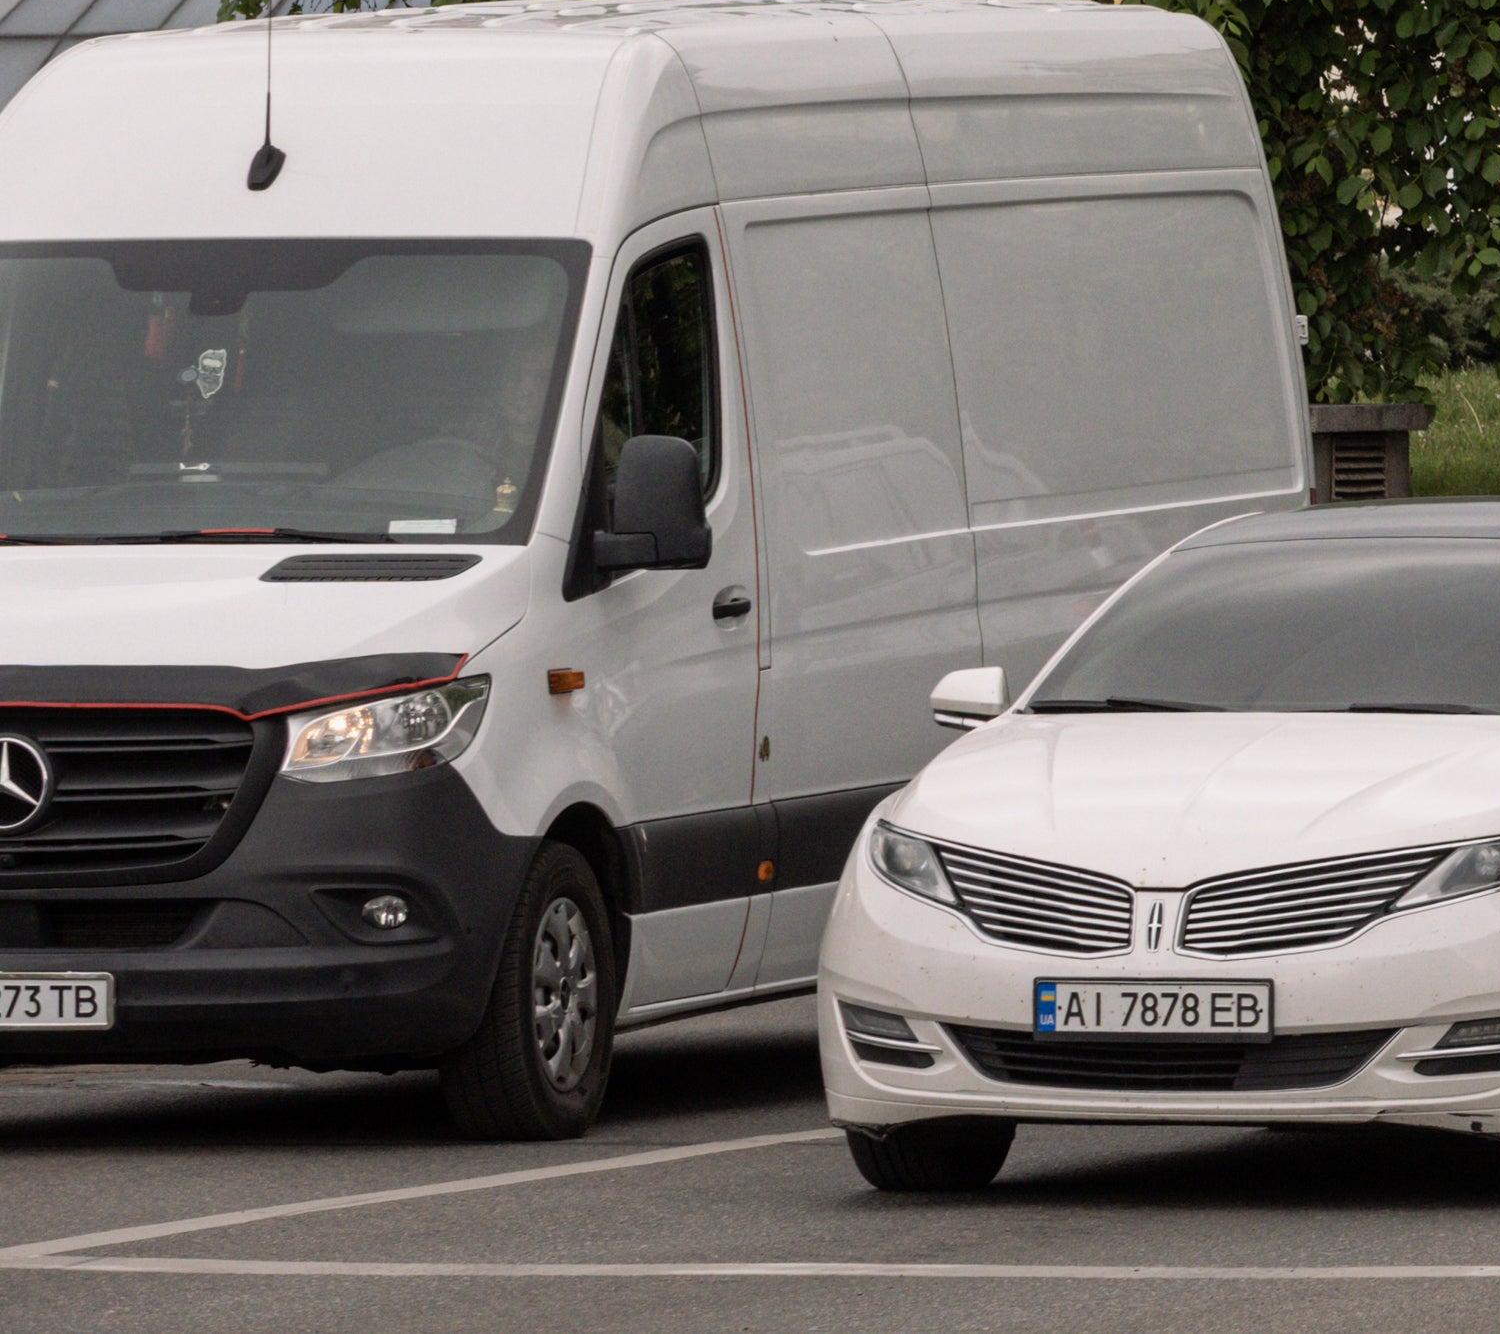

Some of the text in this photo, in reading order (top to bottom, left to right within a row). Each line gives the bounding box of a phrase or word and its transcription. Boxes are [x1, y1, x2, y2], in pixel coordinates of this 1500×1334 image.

[0, 985, 98, 1018] 73 TB
[1040, 992, 1261, 1028] UA AI 7878 EB
